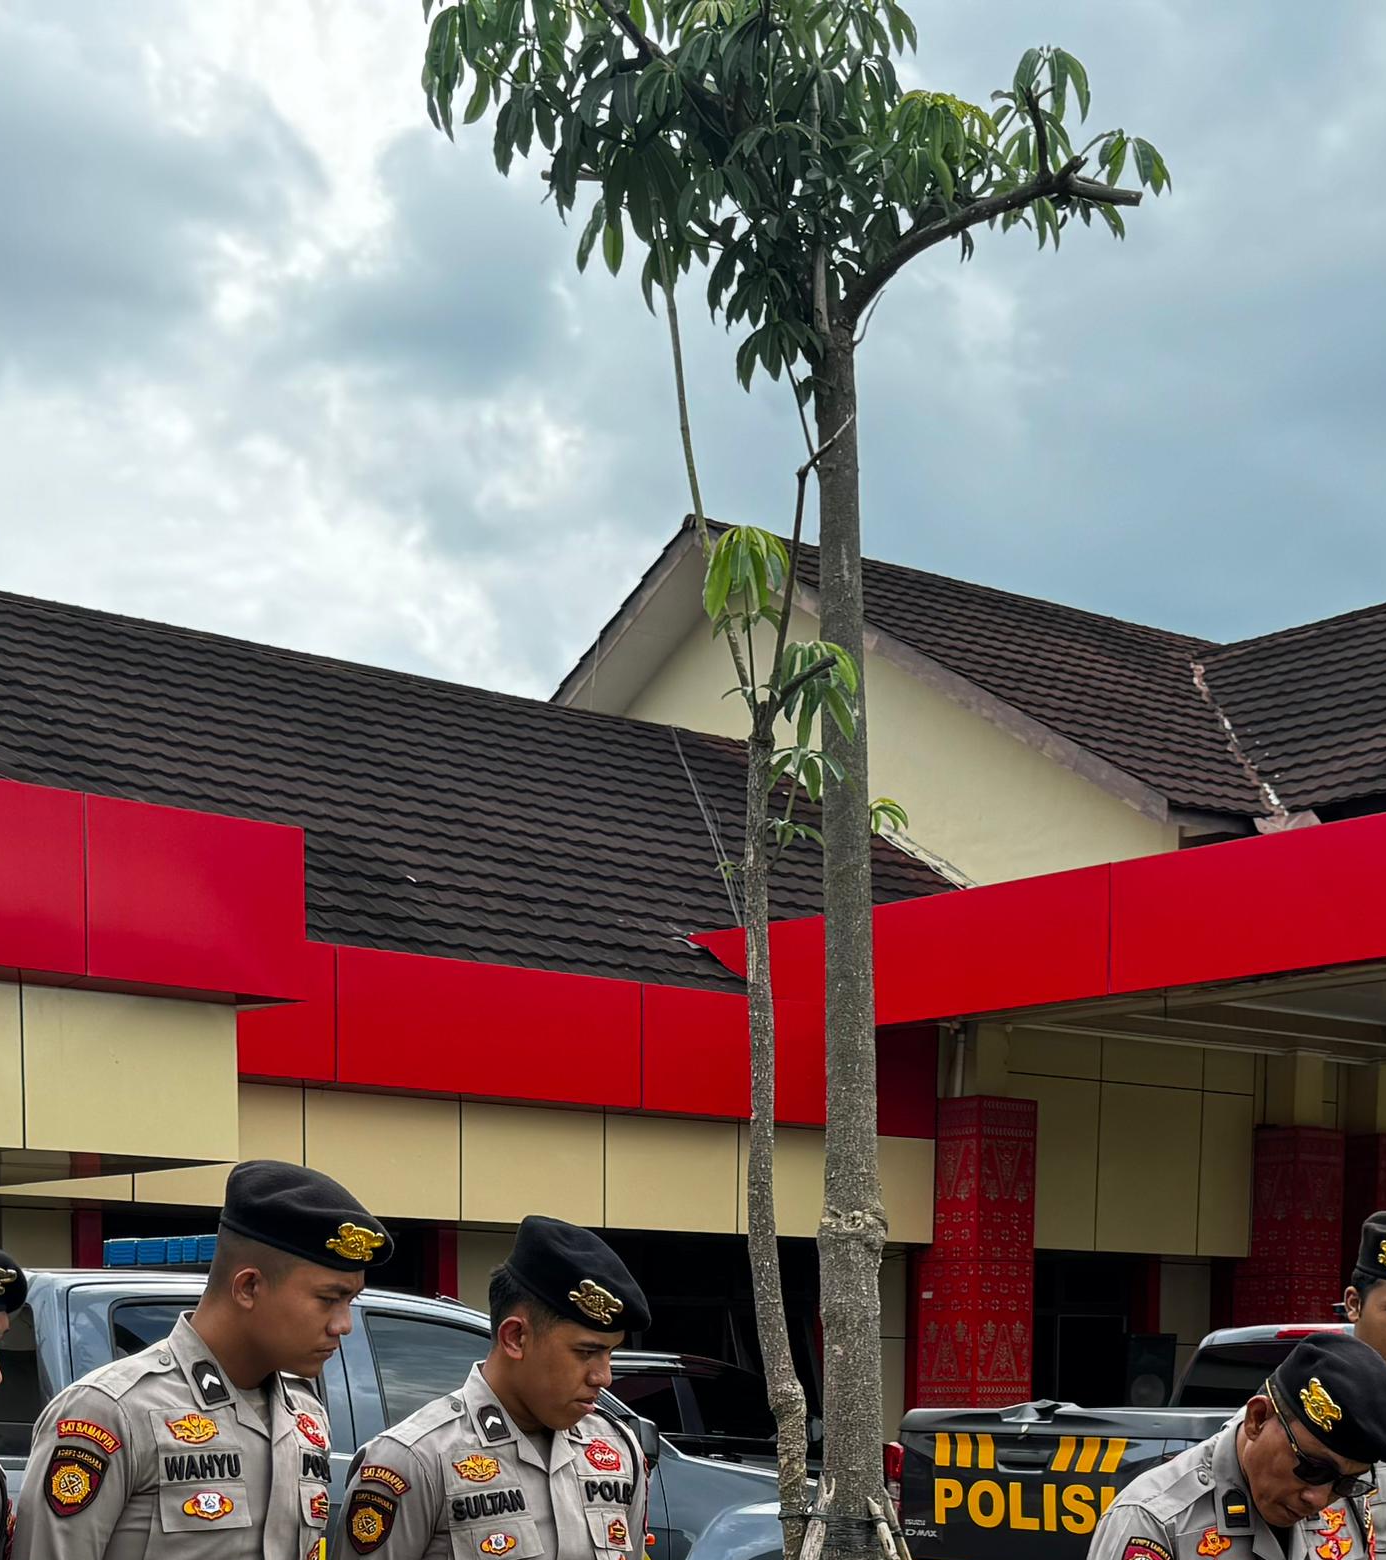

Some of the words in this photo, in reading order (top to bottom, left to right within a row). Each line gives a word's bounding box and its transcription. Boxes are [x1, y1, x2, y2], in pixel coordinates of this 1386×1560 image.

[76, 1423, 116, 1449] SAMAPTA
[164, 1453, 242, 1482] WAHYU
[452, 1488, 526, 1521] SULTAN
[934, 1477, 1116, 1534] POLISI
